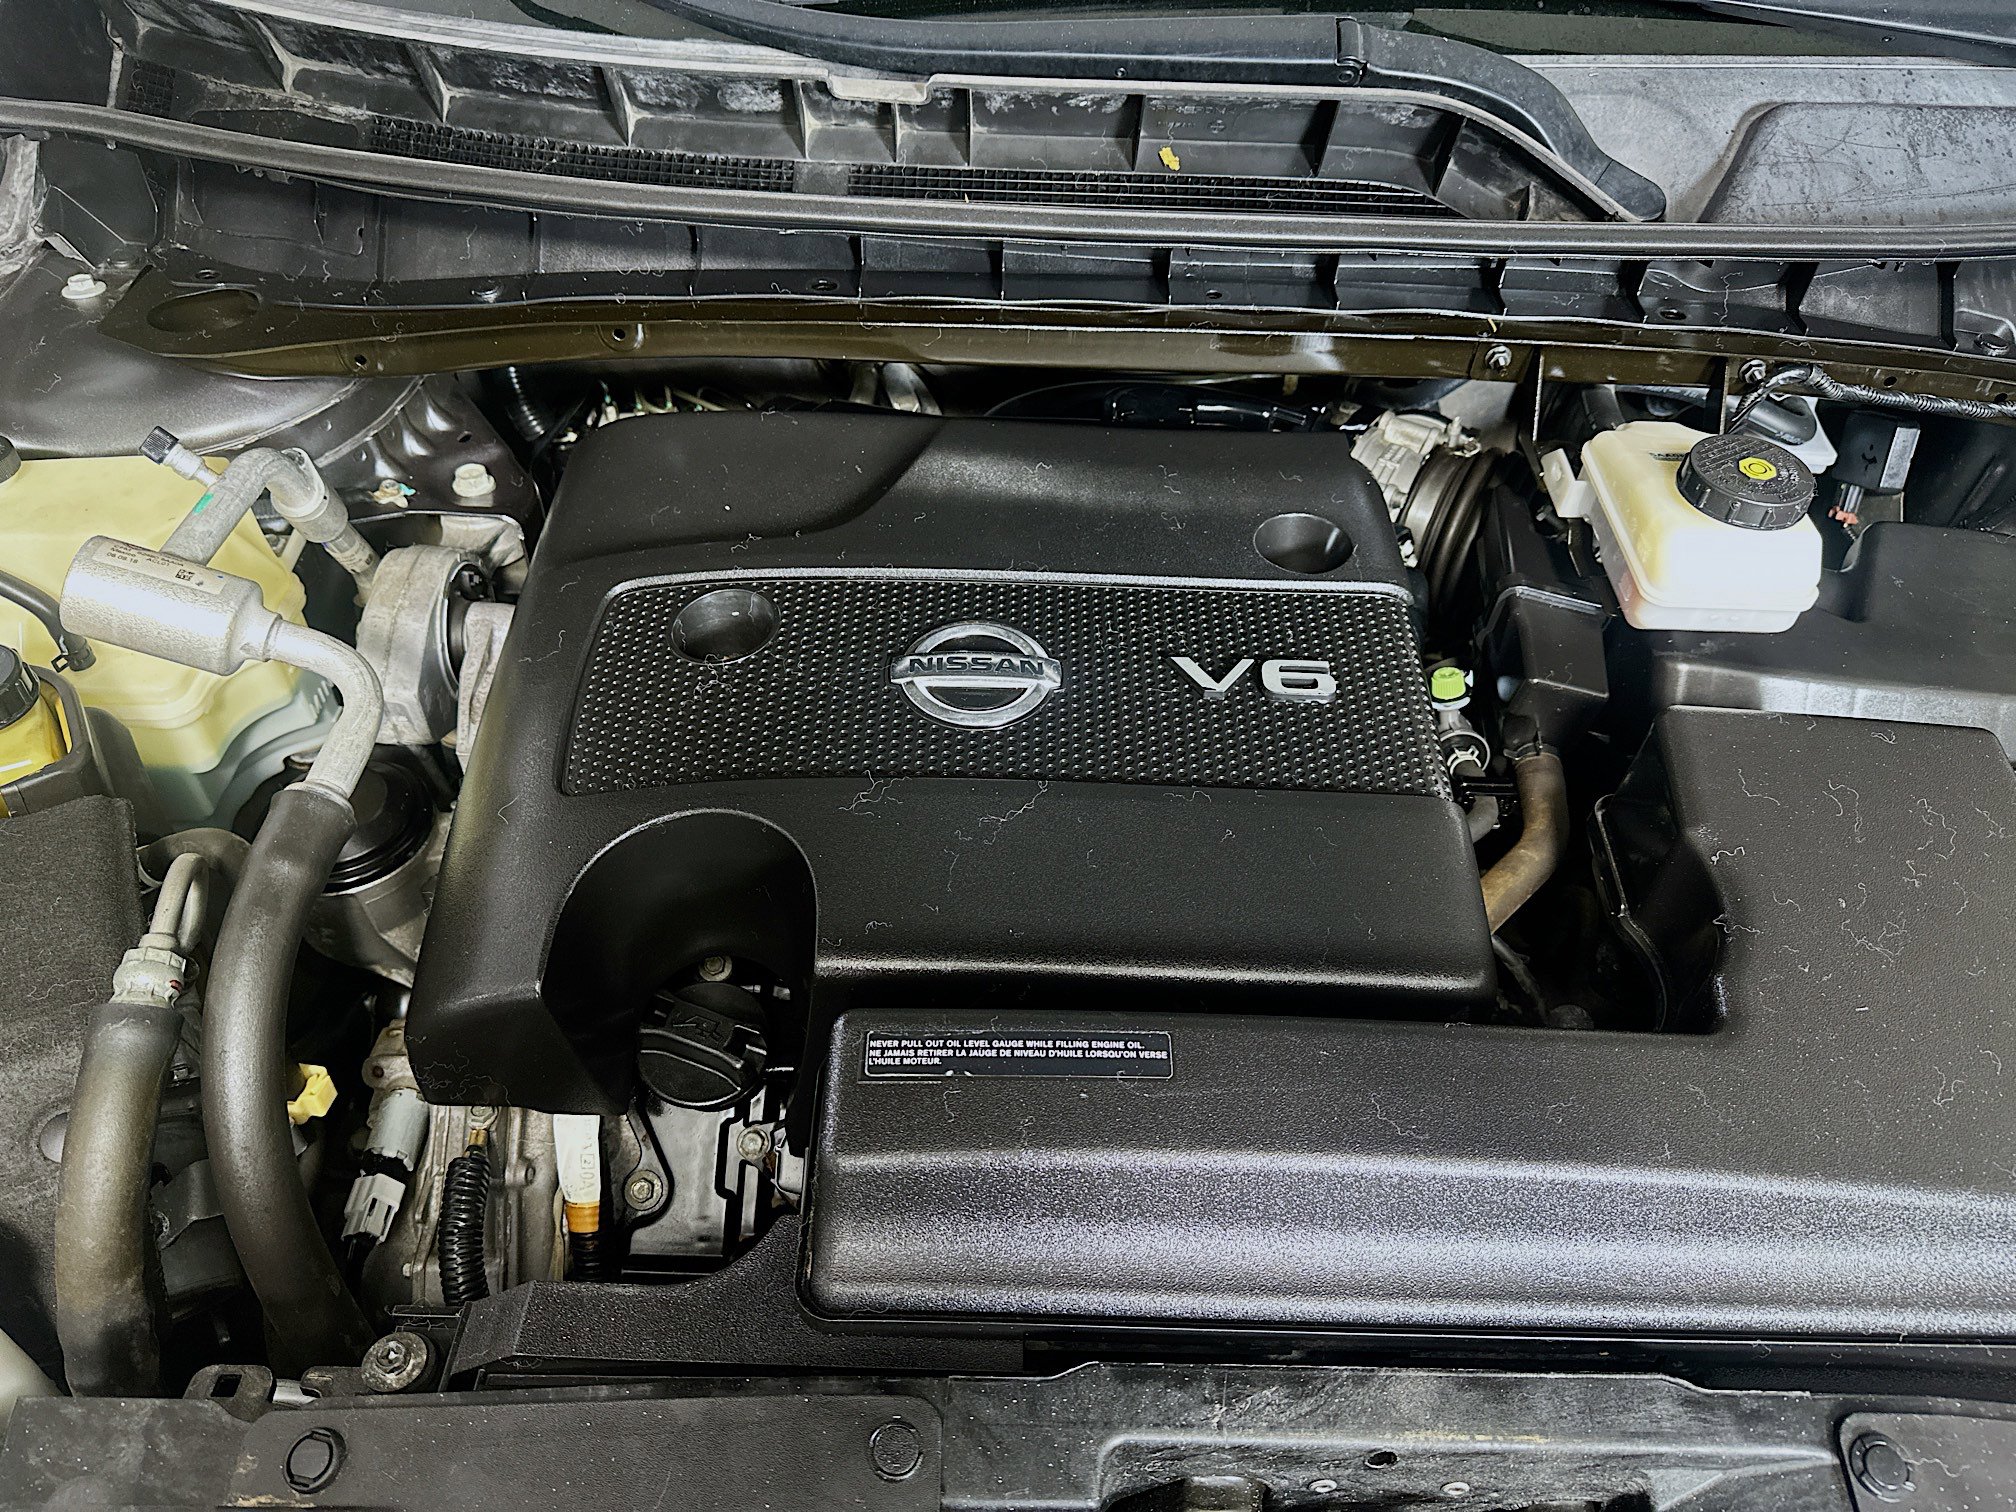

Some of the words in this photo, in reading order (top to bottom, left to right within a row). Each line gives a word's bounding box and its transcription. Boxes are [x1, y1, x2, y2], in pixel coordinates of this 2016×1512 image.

[908, 655, 1045, 677] NISSAN
[1169, 656, 1337, 701] V6
[869, 1039, 899, 1048] NEVER
[901, 1039, 922, 1048] PULL
[925, 1039, 944, 1048] OUT
[946, 1040, 962, 1048] OIL
[963, 1040, 990, 1048] LEVEL
[992, 1040, 1024, 1048] GAUGE
[1026, 1040, 1053, 1049] WHILE
[1055, 1040, 1089, 1049] FILLING
[1091, 1041, 1125, 1049] ENGINE
[1127, 1041, 1145, 1049] OIL.
[869, 1049, 881, 1057] NE
[883, 1049, 915, 1057] JAMAIS
[917, 1049, 954, 1057] RETIRER
[956, 1049, 967, 1057] LA
[969, 1049, 998, 1057] JAUGE
[999, 1049, 1012, 1057] DE
[1014, 1049, 1046, 1057] NIVEAU
[1048, 1050, 1083, 1058] D'HUILE
[1085, 1050, 1137, 1058] LORSQU'ON
[1139, 1050, 1168, 1059] VERSE
[868, 1057, 901, 1065] L'HUILE
[902, 1057, 942, 1065] MOTEUR.
